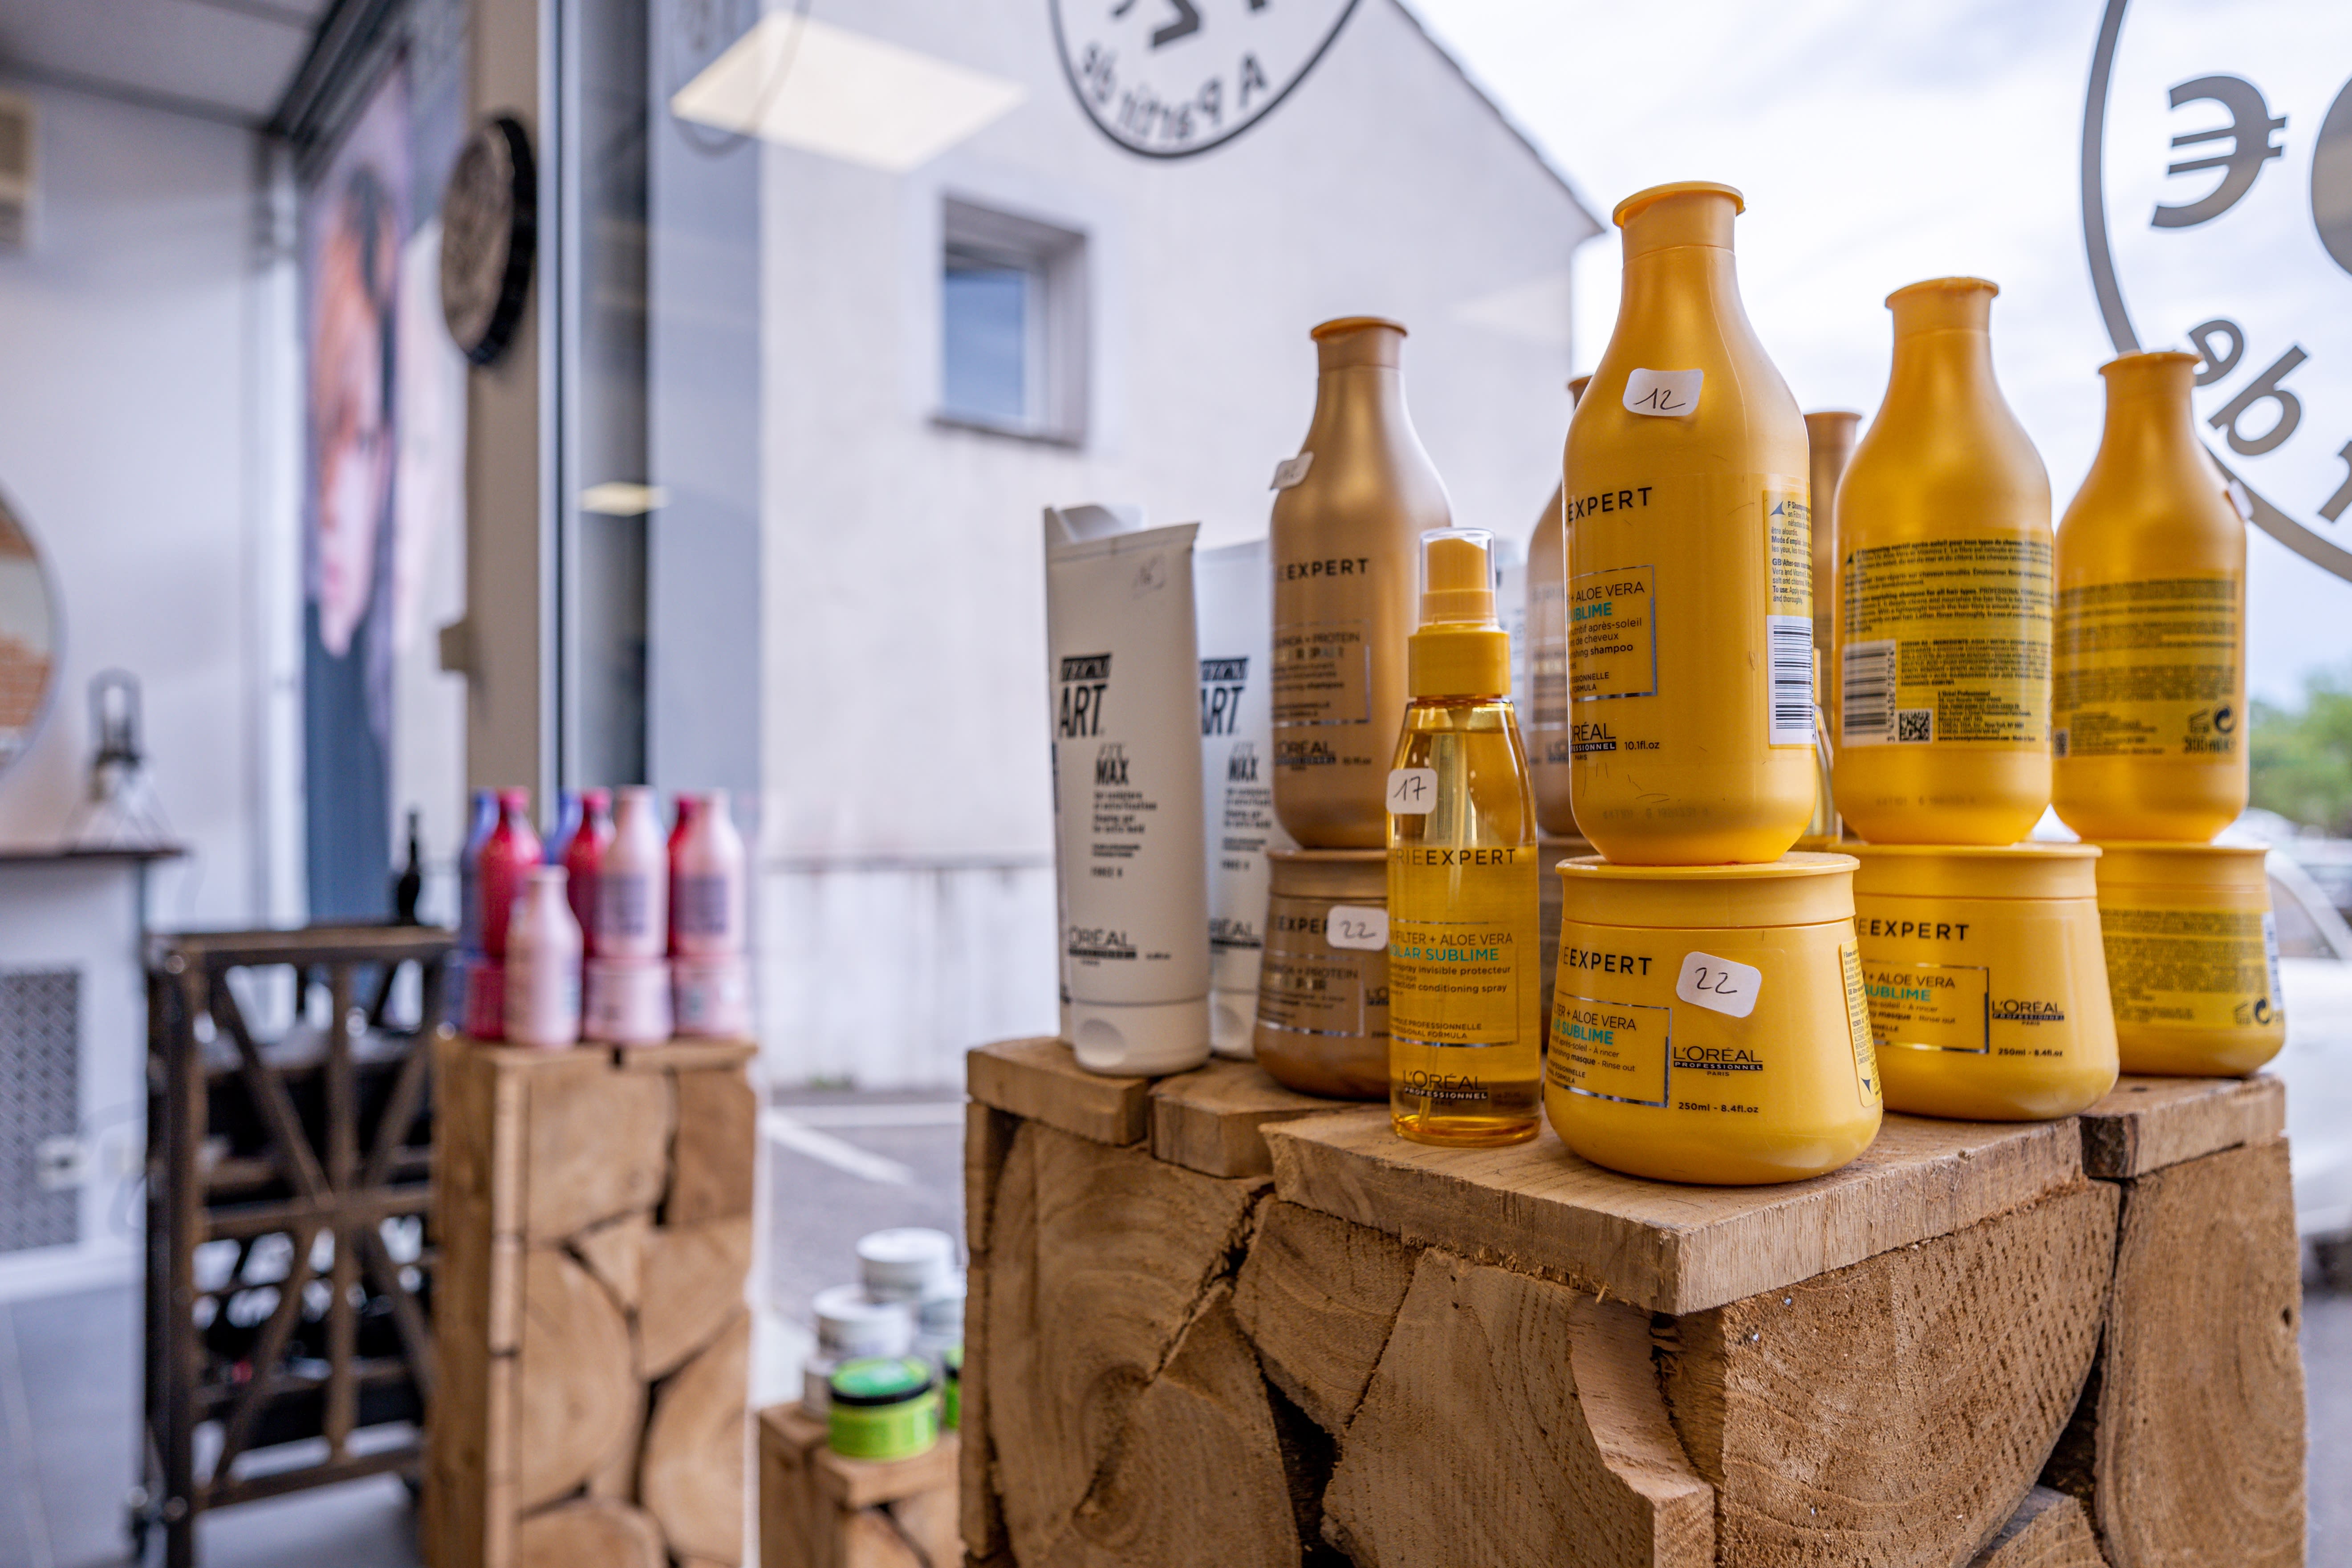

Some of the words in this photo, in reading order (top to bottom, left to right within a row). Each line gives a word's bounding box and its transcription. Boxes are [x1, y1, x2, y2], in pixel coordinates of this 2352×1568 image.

[1633, 388, 1686, 410] 12
[1568, 487, 1652, 522] EXPERT
[1771, 536, 1785, 544] Mode
[1287, 558, 1369, 580] EXPERT
[1576, 586, 1602, 602] ALOE
[1605, 581, 1645, 597] VERA
[1570, 601, 1613, 622] UBLIME
[1570, 624, 1587, 636] utritif
[1588, 617, 1642, 635] après-soleil
[1576, 636, 1583, 645] de
[1584, 633, 1619, 644] cheveux
[1590, 644, 1633, 655] shampoo
[1572, 671, 1609, 684] ESSIONNELLE
[1060, 684, 1108, 738] ART
[1624, 740, 1660, 750] 10.1fl.oz
[1393, 776, 1427, 801] 17
[1426, 848, 1515, 865] EXPERT
[1279, 915, 1328, 934] EXPE
[1339, 920, 1377, 939] 22
[1870, 919, 1970, 941] EXPERT
[1440, 934, 1476, 946] ALOE
[1479, 933, 1513, 945] VERA
[1389, 944, 1422, 960] OLAR
[1426, 947, 1499, 962] SUBLIME
[1570, 948, 1652, 976] EXPERT
[1418, 965, 1457, 975] invisible
[1460, 966, 1511, 976] protecteur
[1418, 984, 1479, 994] conditioning
[1482, 984, 1507, 993] spray
[1695, 967, 1737, 994] 22
[1877, 972, 1913, 986] ALOE
[1916, 975, 1955, 988] VERA
[1572, 1009, 1598, 1026] ALOE
[1601, 1015, 1637, 1031] VERA
[1561, 1021, 1614, 1045] SUBLIME
[1571, 1053, 1596, 1065] masque
[1602, 1060, 1621, 1070] Rinse
[1600, 1049, 1619, 1058] rincer
[1674, 1046, 1763, 1062] L'ORÉAL
[1674, 1061, 1763, 1070] PROFESSIONNEL
[1403, 1069, 1488, 1091] L'ORÉAL
[1404, 1086, 1487, 1100] PROFESSIONNEL
[1678, 1102, 1710, 1111] 250ml
[1721, 1105, 1759, 1113] 8.4fl.oz
